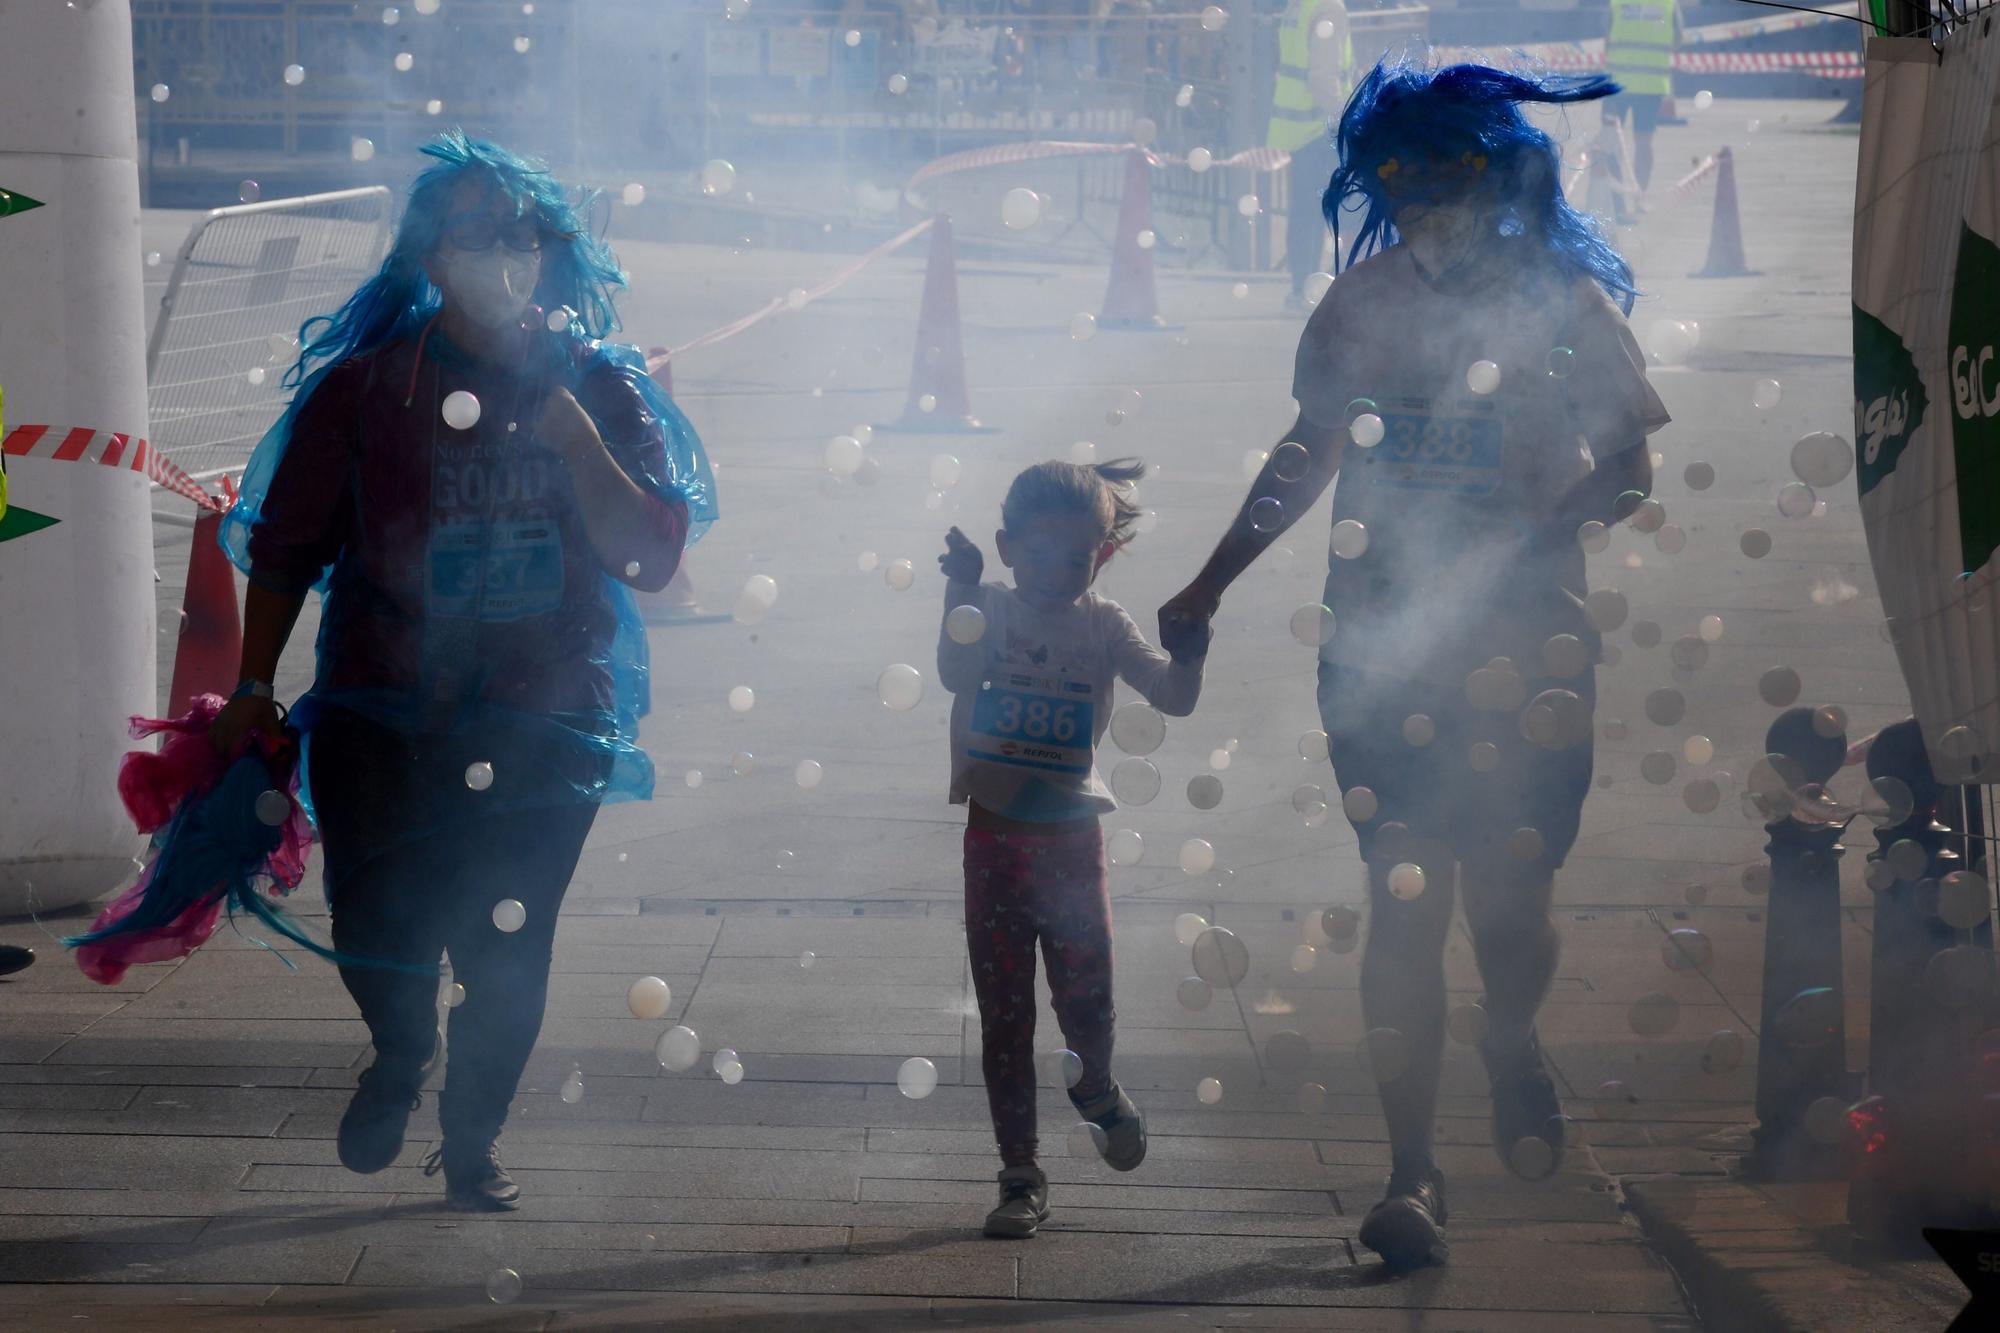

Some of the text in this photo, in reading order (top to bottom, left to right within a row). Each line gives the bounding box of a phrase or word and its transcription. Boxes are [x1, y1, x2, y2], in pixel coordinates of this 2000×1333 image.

[436, 444, 462, 460] No
[1392, 419, 1473, 460] 388
[435, 461, 548, 508] GOOD
[994, 695, 1076, 742] 386
[1022, 747, 1064, 761] REPSOL
